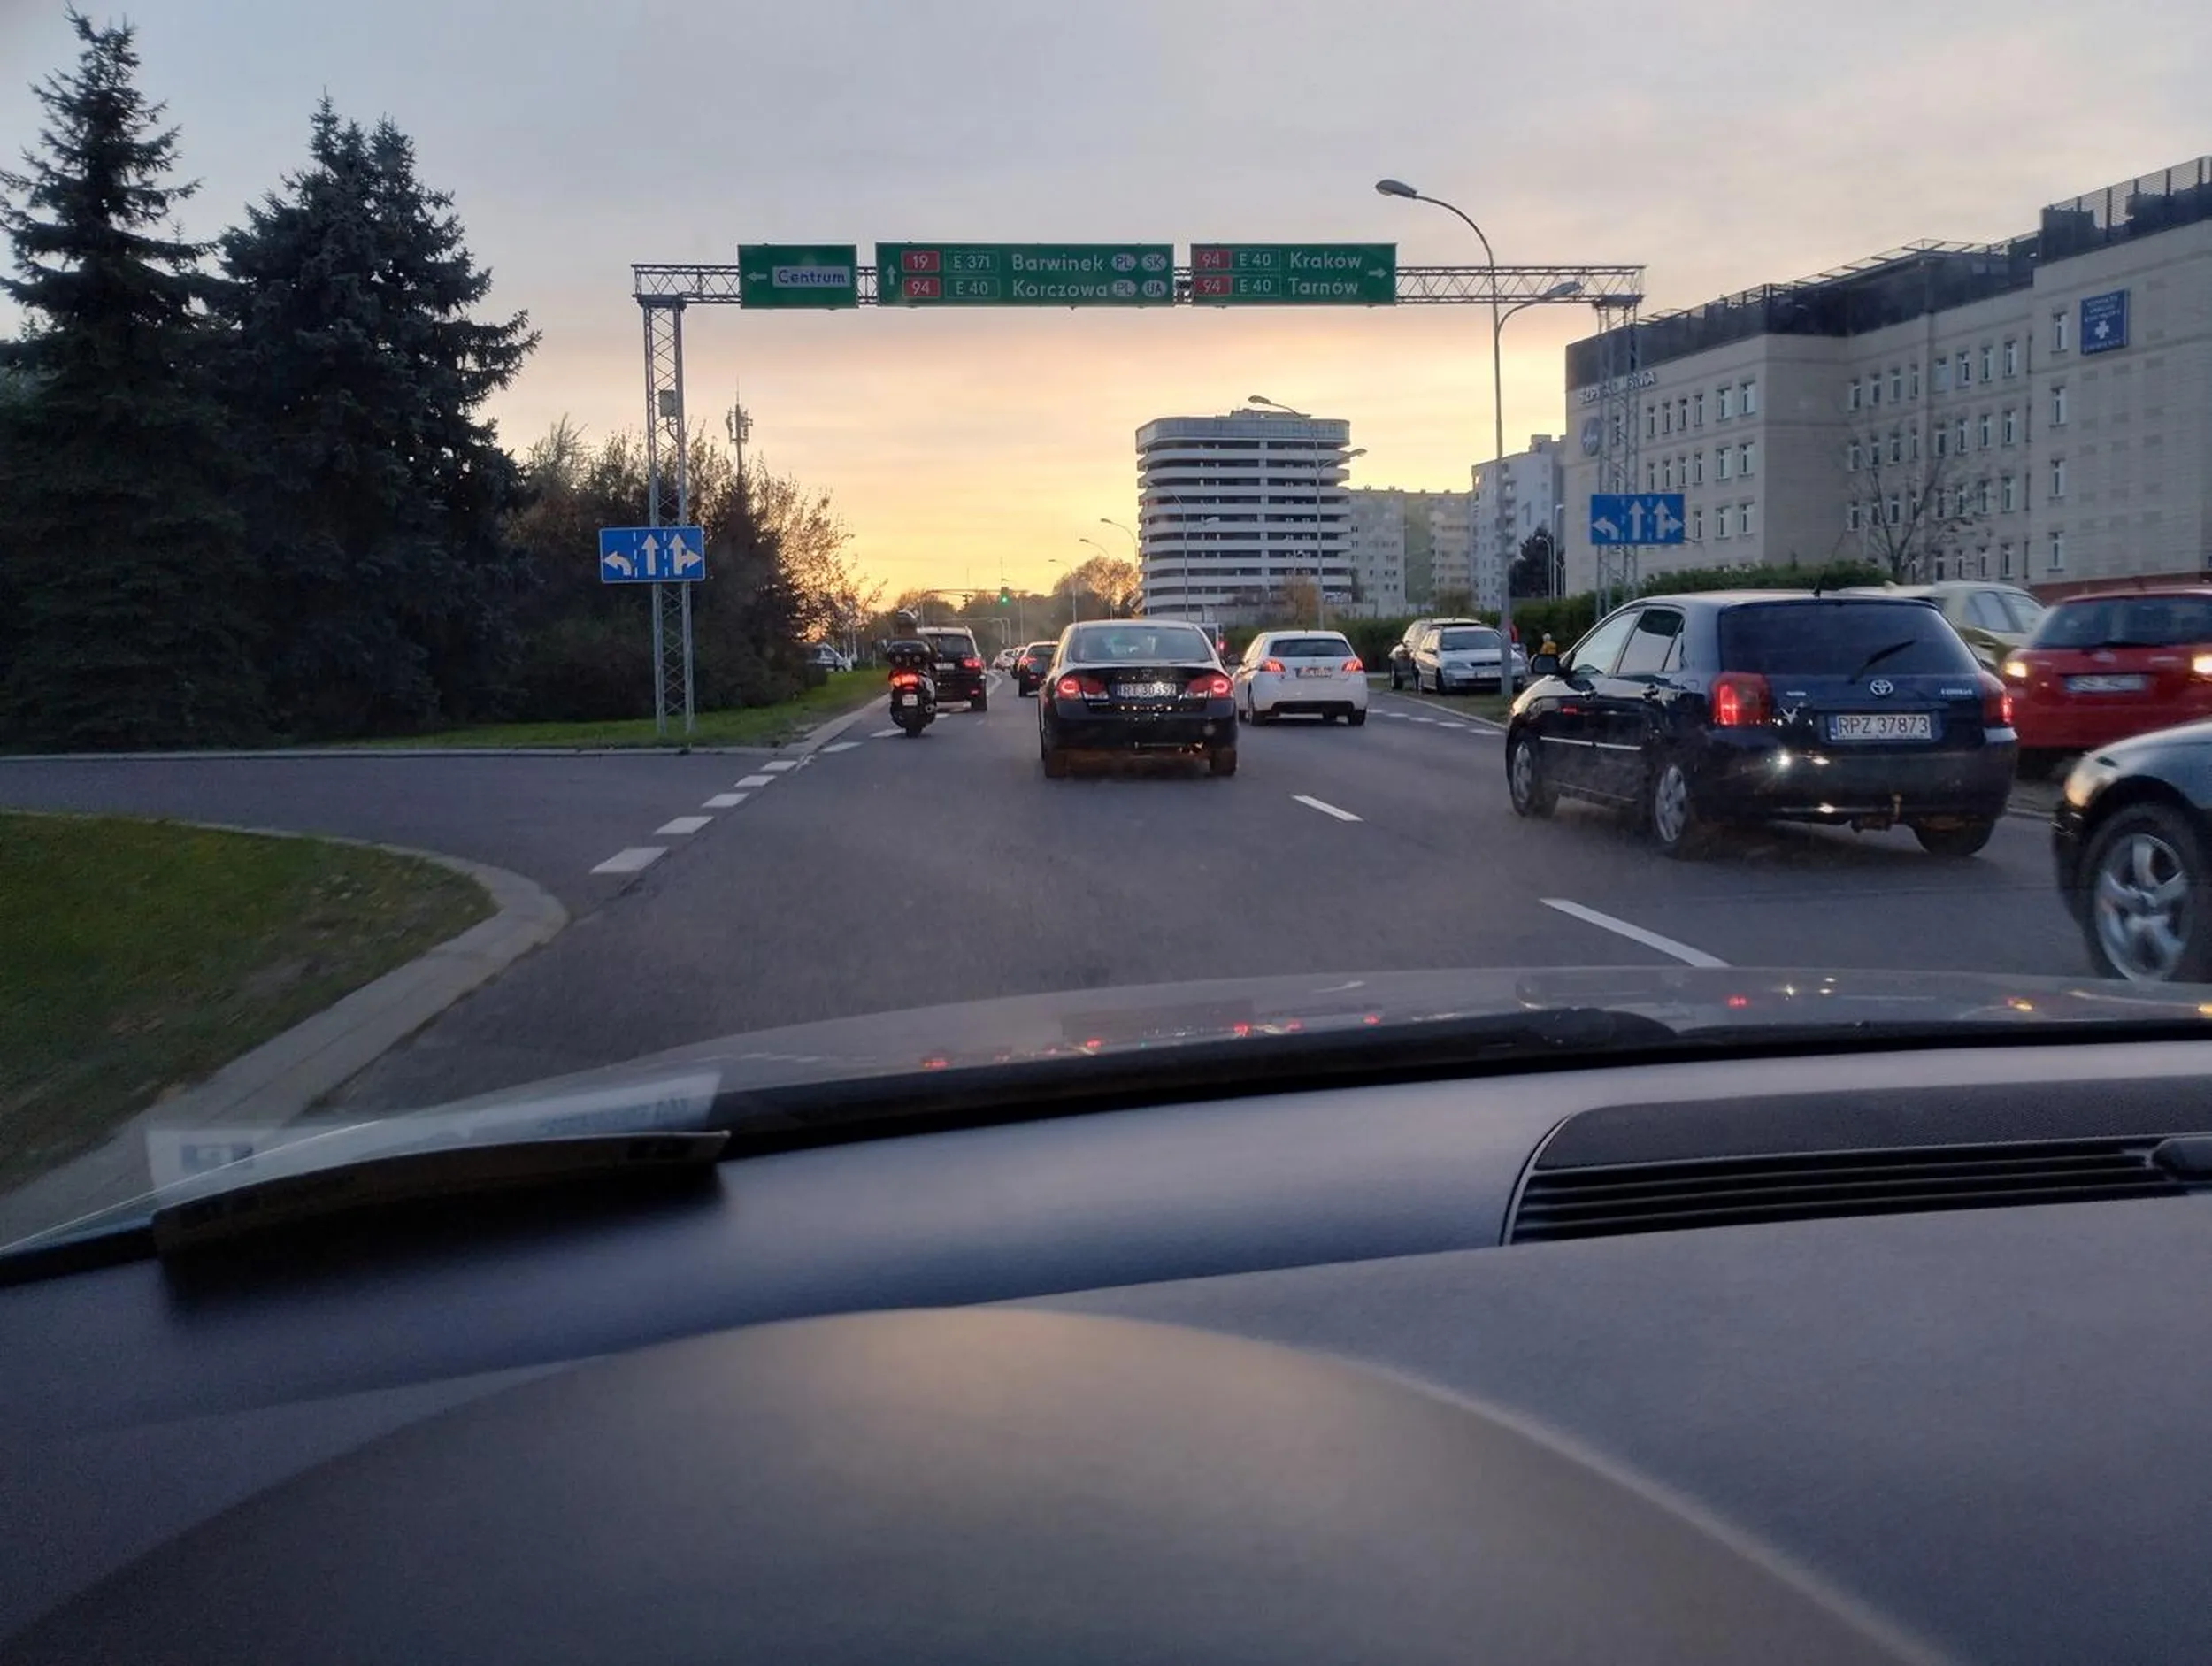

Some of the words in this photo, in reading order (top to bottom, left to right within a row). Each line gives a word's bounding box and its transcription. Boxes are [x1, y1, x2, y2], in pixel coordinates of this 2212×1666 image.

[912, 255, 928, 269] 19
[953, 255, 962, 269] E
[967, 254, 990, 269] 371
[1012, 253, 1104, 271] Barwinek
[1116, 257, 1132, 269] PL
[1202, 253, 1220, 265] 94
[1240, 253, 1248, 266] E
[1251, 253, 1271, 266] 40
[1290, 250, 1362, 269] Kraków
[778, 269, 846, 284] Centrum
[911, 280, 929, 295] 94
[956, 281, 964, 295] E
[969, 281, 988, 295] 40
[1012, 279, 1108, 297] Korczowa
[1202, 280, 1221, 293] 94
[1240, 279, 1248, 293] E
[1252, 279, 1271, 292] 40
[1287, 277, 1358, 295] Tarnów
[1839, 717, 1871, 733] RPZ
[1877, 717, 1928, 733] 37873
